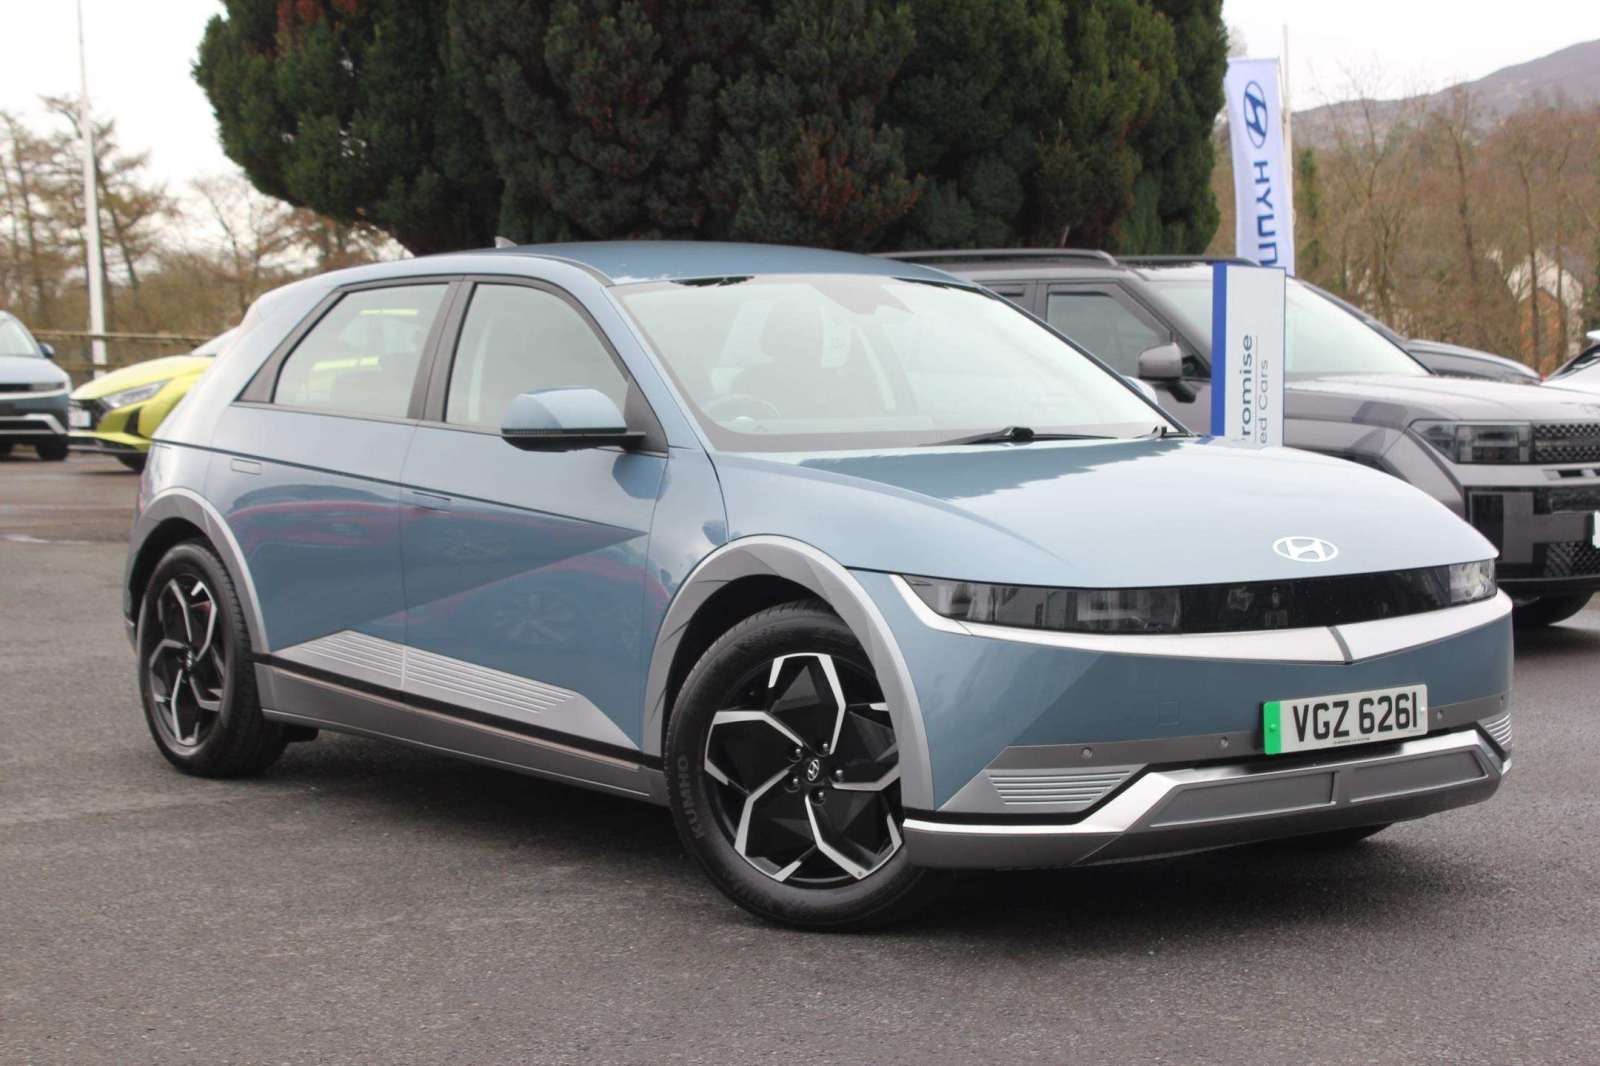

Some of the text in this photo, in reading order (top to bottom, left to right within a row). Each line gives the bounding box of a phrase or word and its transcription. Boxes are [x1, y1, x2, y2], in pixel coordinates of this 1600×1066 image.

[1240, 335, 1252, 440] romise
[1259, 360, 1268, 410] Cars
[1292, 692, 1418, 742] VGZ 6261
